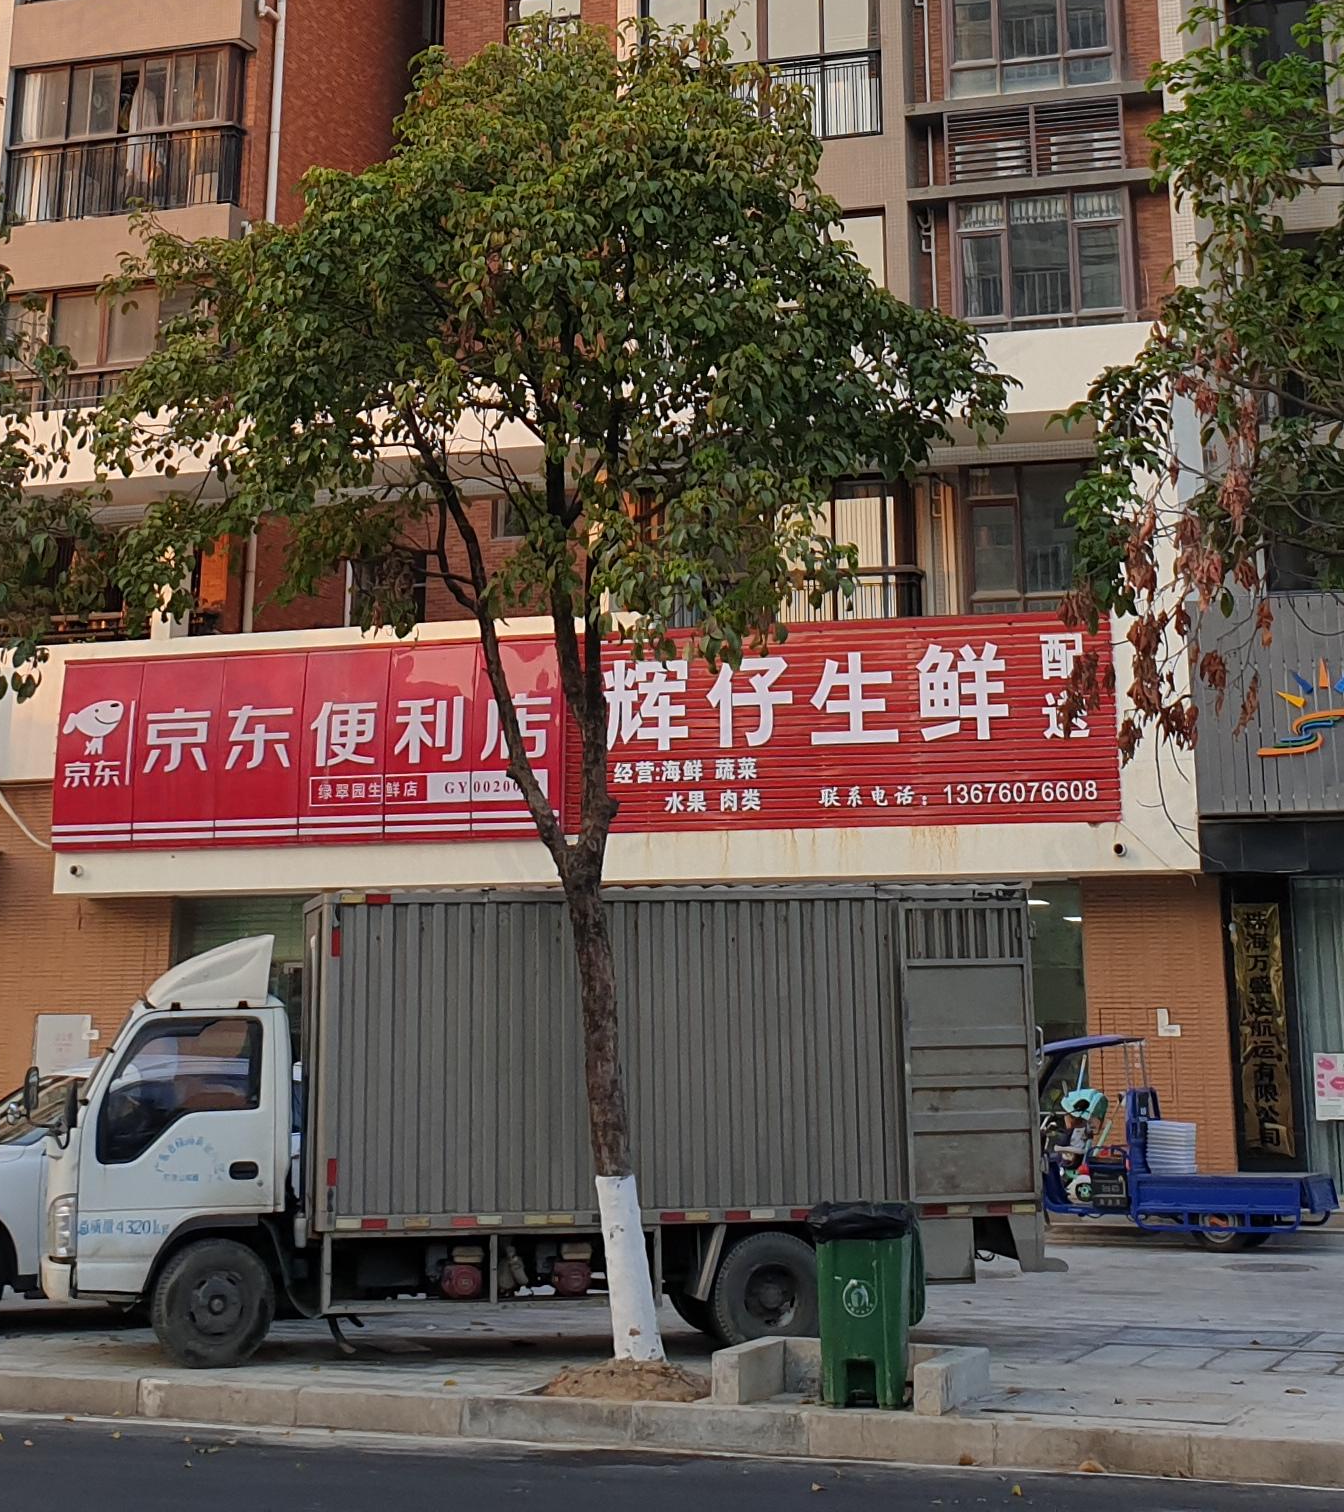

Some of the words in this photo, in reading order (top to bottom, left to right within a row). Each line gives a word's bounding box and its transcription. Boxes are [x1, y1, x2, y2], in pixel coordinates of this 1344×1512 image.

[603, 641, 1010, 752] 辉仔生鲜
[142, 694, 554, 774] 京东便利店
[62, 760, 121, 788] 京东
[714, 756, 758, 781] 蔬菜
[317, 781, 419, 799] 绿翠园生鲜店
[664, 790, 707, 813] 水果
[719, 788, 762, 813] 肉类
